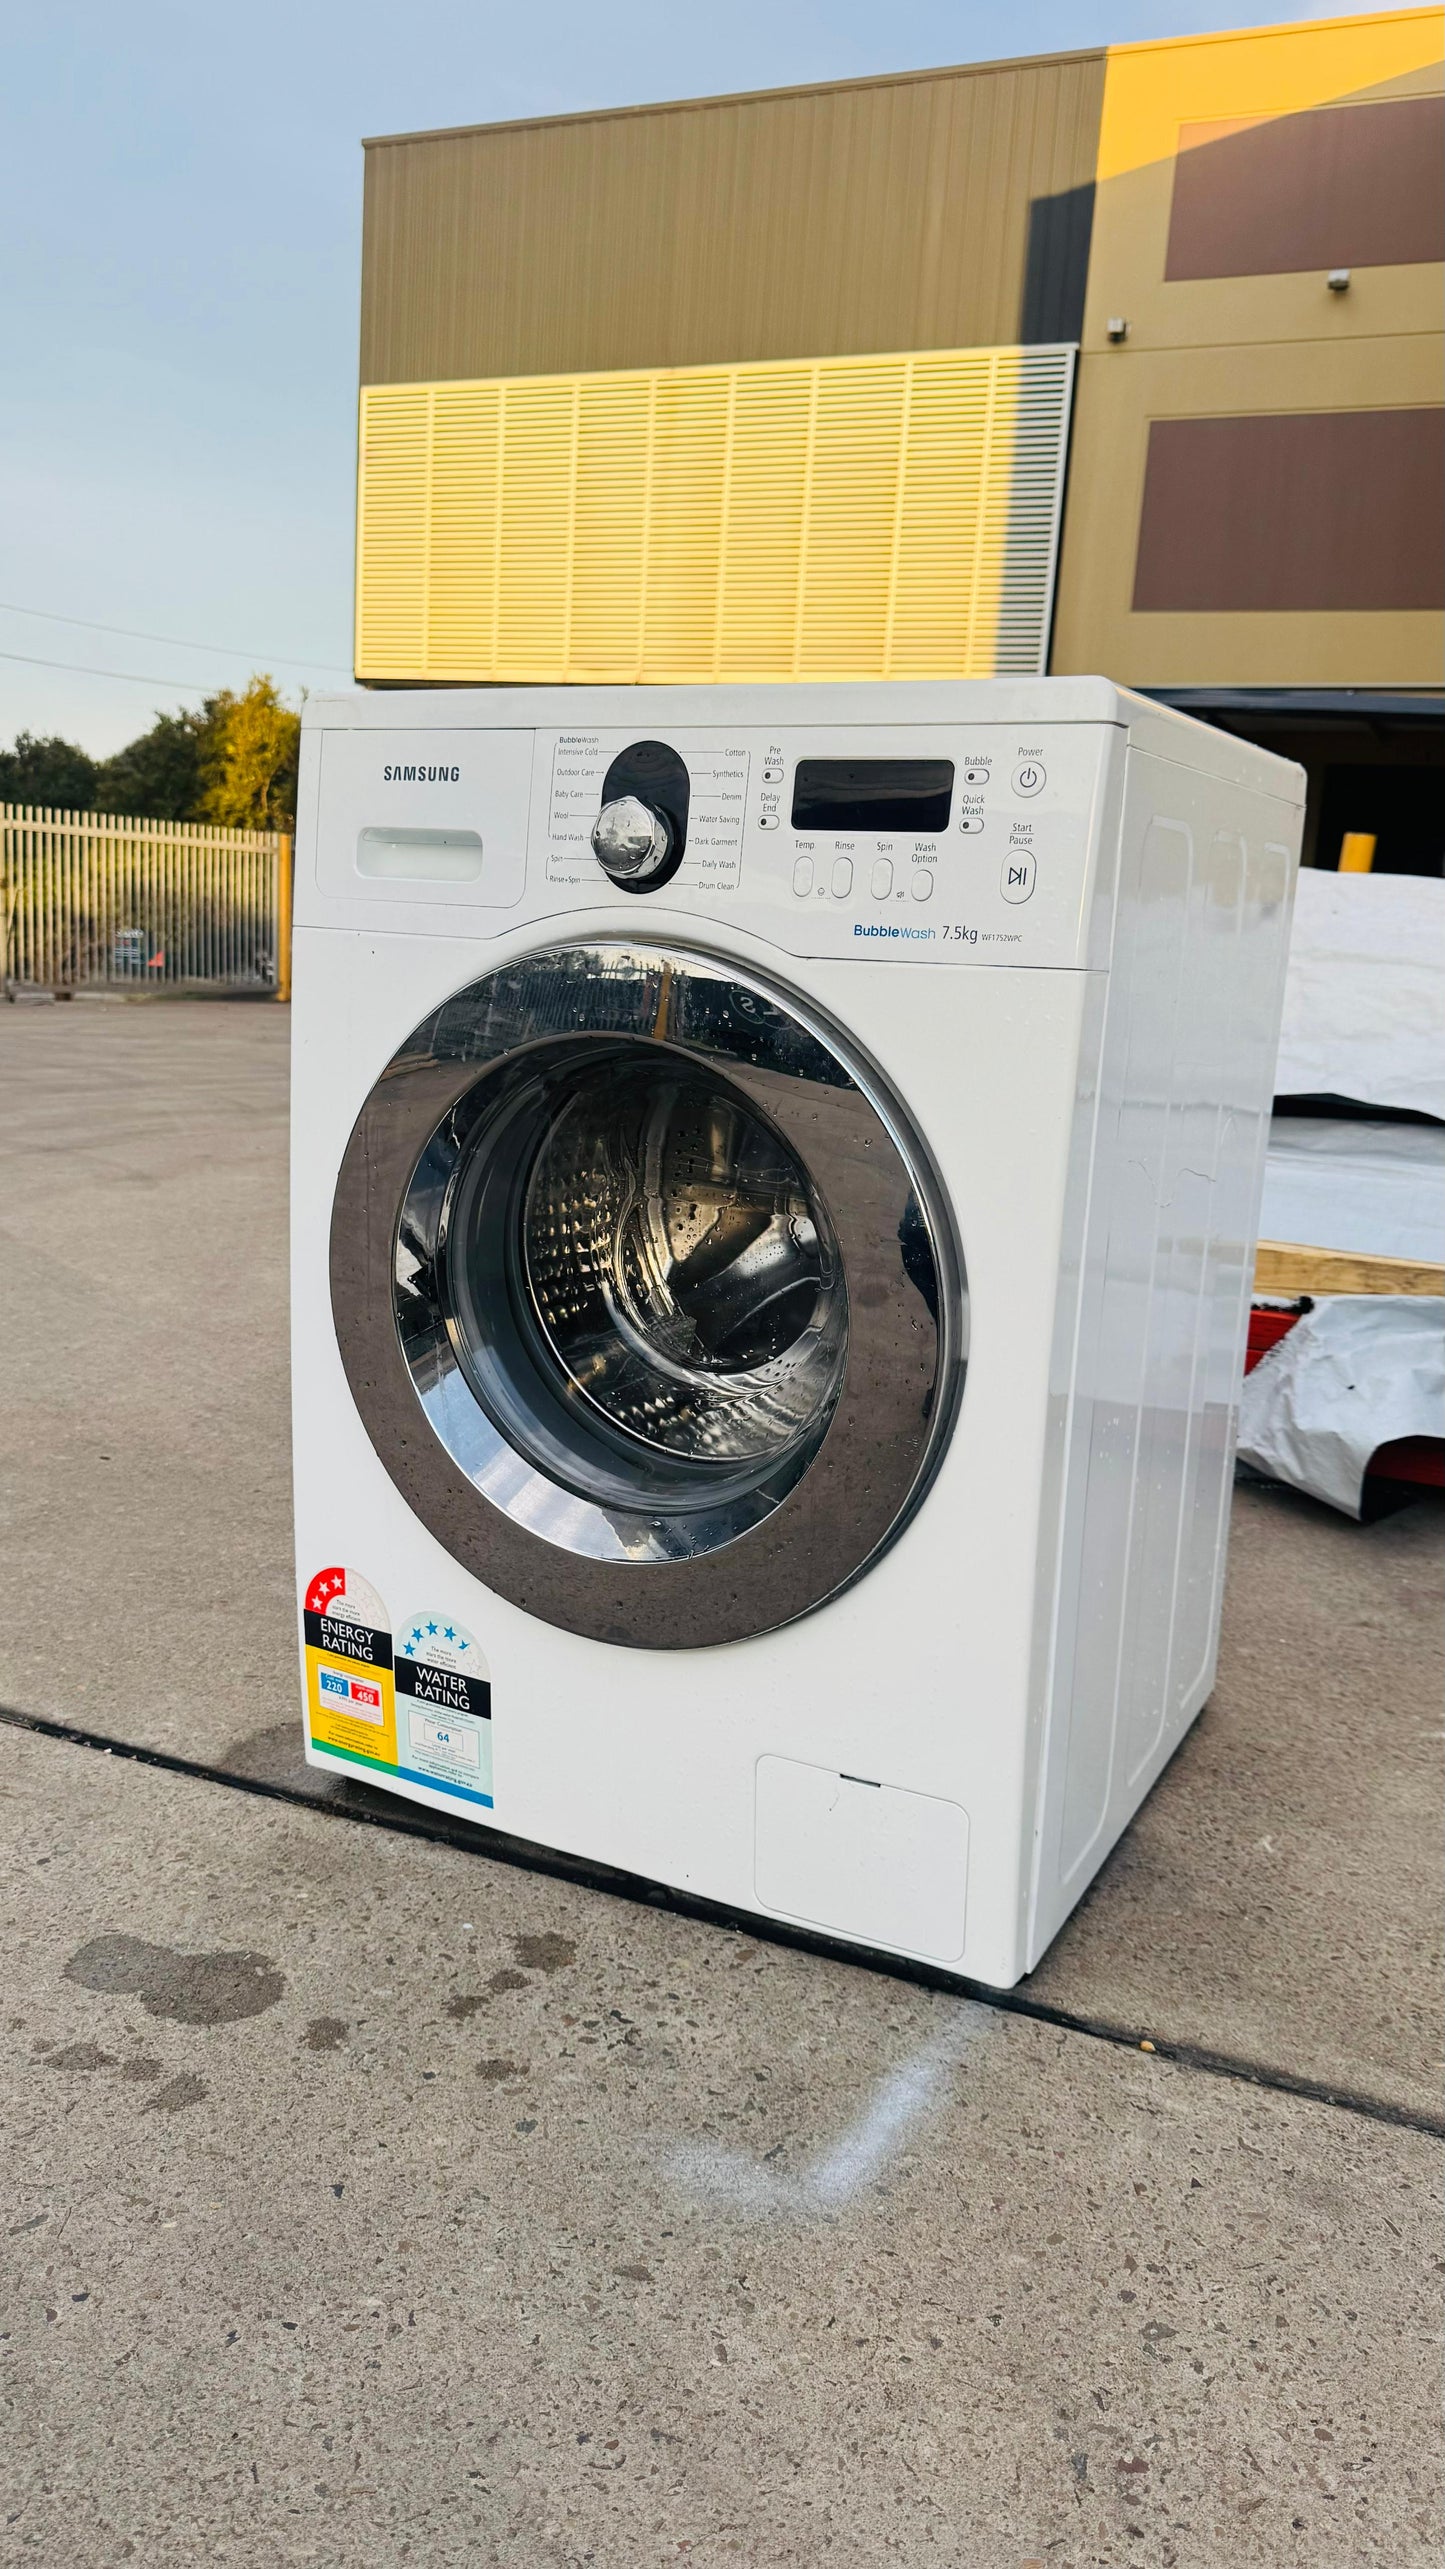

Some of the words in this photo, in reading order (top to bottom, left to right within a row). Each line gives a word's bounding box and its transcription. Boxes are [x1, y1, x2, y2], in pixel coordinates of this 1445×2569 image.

[559, 736, 599, 744] BubbleWash
[558, 748, 584, 756] Intensive
[584, 748, 598, 756] Cold
[724, 749, 746, 757] Cotton
[769, 746, 781, 755] Pre
[1018, 747, 1043, 757] Power
[764, 756, 784, 766] Wash
[964, 757, 993, 766] Bubble
[384, 766, 460, 782] SAMSUNG
[556, 768, 580, 776] Outdoor
[581, 768, 595, 776] Care
[712, 770, 744, 780] Synthetics
[554, 790, 569, 799] Baby
[722, 792, 742, 800] Denim
[760, 793, 781, 804] Delay
[962, 794, 985, 804] Quick
[762, 804, 777, 812] End
[962, 805, 984, 816] Wash
[719, 816, 740, 826] Saving
[1012, 822, 1032, 832] Start
[552, 833, 568, 841] Hand
[568, 834, 584, 842] Wash
[694, 837, 710, 846] Dark
[710, 838, 738, 846] Garment
[1009, 836, 1033, 845] Pause
[795, 840, 815, 851] Temp
[834, 841, 855, 850] Rinse
[876, 842, 893, 852] Spin
[914, 842, 936, 852] Wash
[912, 854, 938, 864] Option
[702, 860, 718, 870] Daily
[718, 860, 736, 868] Wash
[698, 882, 716, 890] Drum
[716, 882, 735, 891] Clean
[854, 924, 936, 940] BubbleWash
[942, 926, 978, 945] 7.5kg
[320, 1618, 374, 1645] ENERGY
[322, 1634, 374, 1661] RATING
[416, 1666, 468, 1694] WATER
[326, 1680, 342, 1694] 220
[356, 1691, 374, 1704] 450
[415, 1681, 470, 1710] RATING
[436, 1732, 450, 1743] 64
